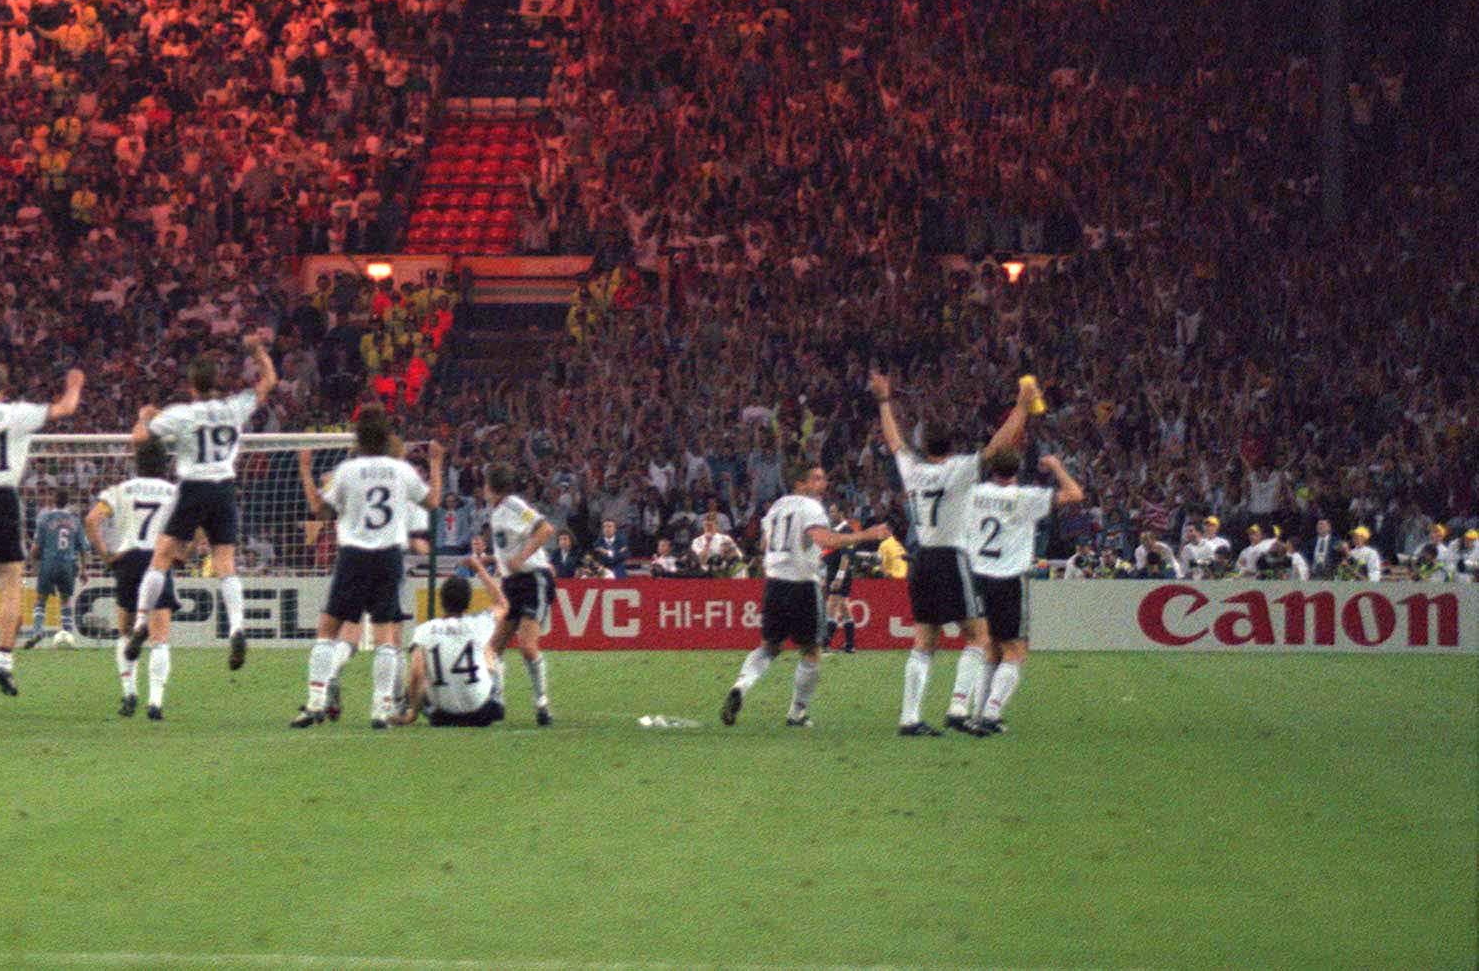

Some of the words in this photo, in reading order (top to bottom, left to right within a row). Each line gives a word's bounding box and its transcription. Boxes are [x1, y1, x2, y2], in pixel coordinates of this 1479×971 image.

[193, 425, 238, 464] 19
[133, 500, 162, 541] 7
[364, 486, 393, 530] 3
[58, 529, 69, 550] 6
[769, 511, 795, 552] 11
[978, 516, 1002, 559] 2
[658, 599, 733, 629] HI-FI
[742, 600, 763, 628] &
[1136, 584, 1460, 647] Canon
[429, 639, 480, 687] 14
